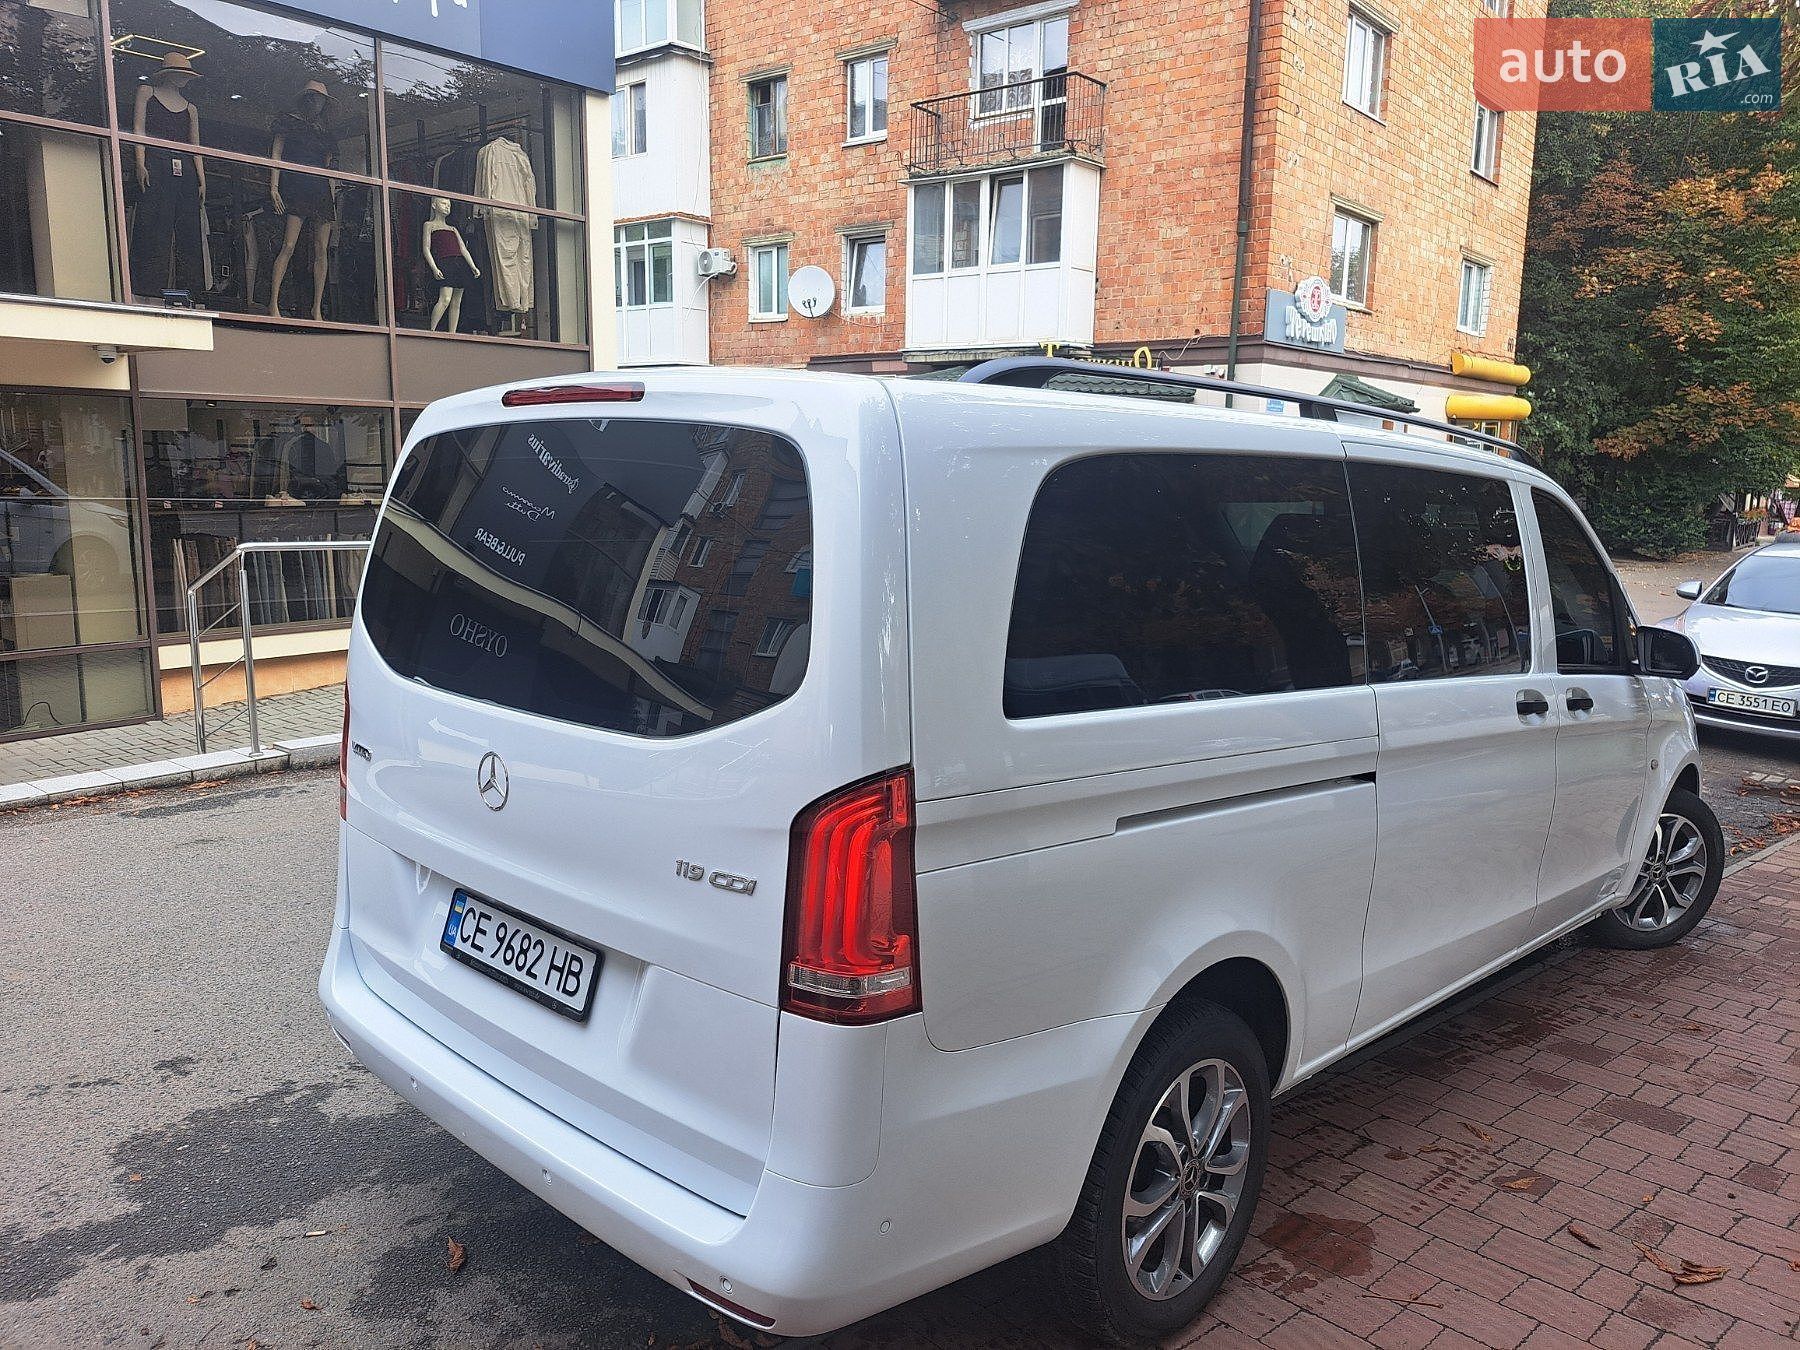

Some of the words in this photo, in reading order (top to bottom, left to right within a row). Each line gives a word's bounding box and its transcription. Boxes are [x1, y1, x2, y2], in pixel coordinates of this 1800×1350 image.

[1717, 692, 1736, 705] CE
[1738, 695, 1768, 710] 3551
[1771, 700, 1791, 713] EO
[675, 859, 705, 882] 119
[708, 870, 758, 897] CDI
[460, 907, 493, 954] CE
[490, 921, 545, 981] 9682
[545, 945, 584, 998] HB
